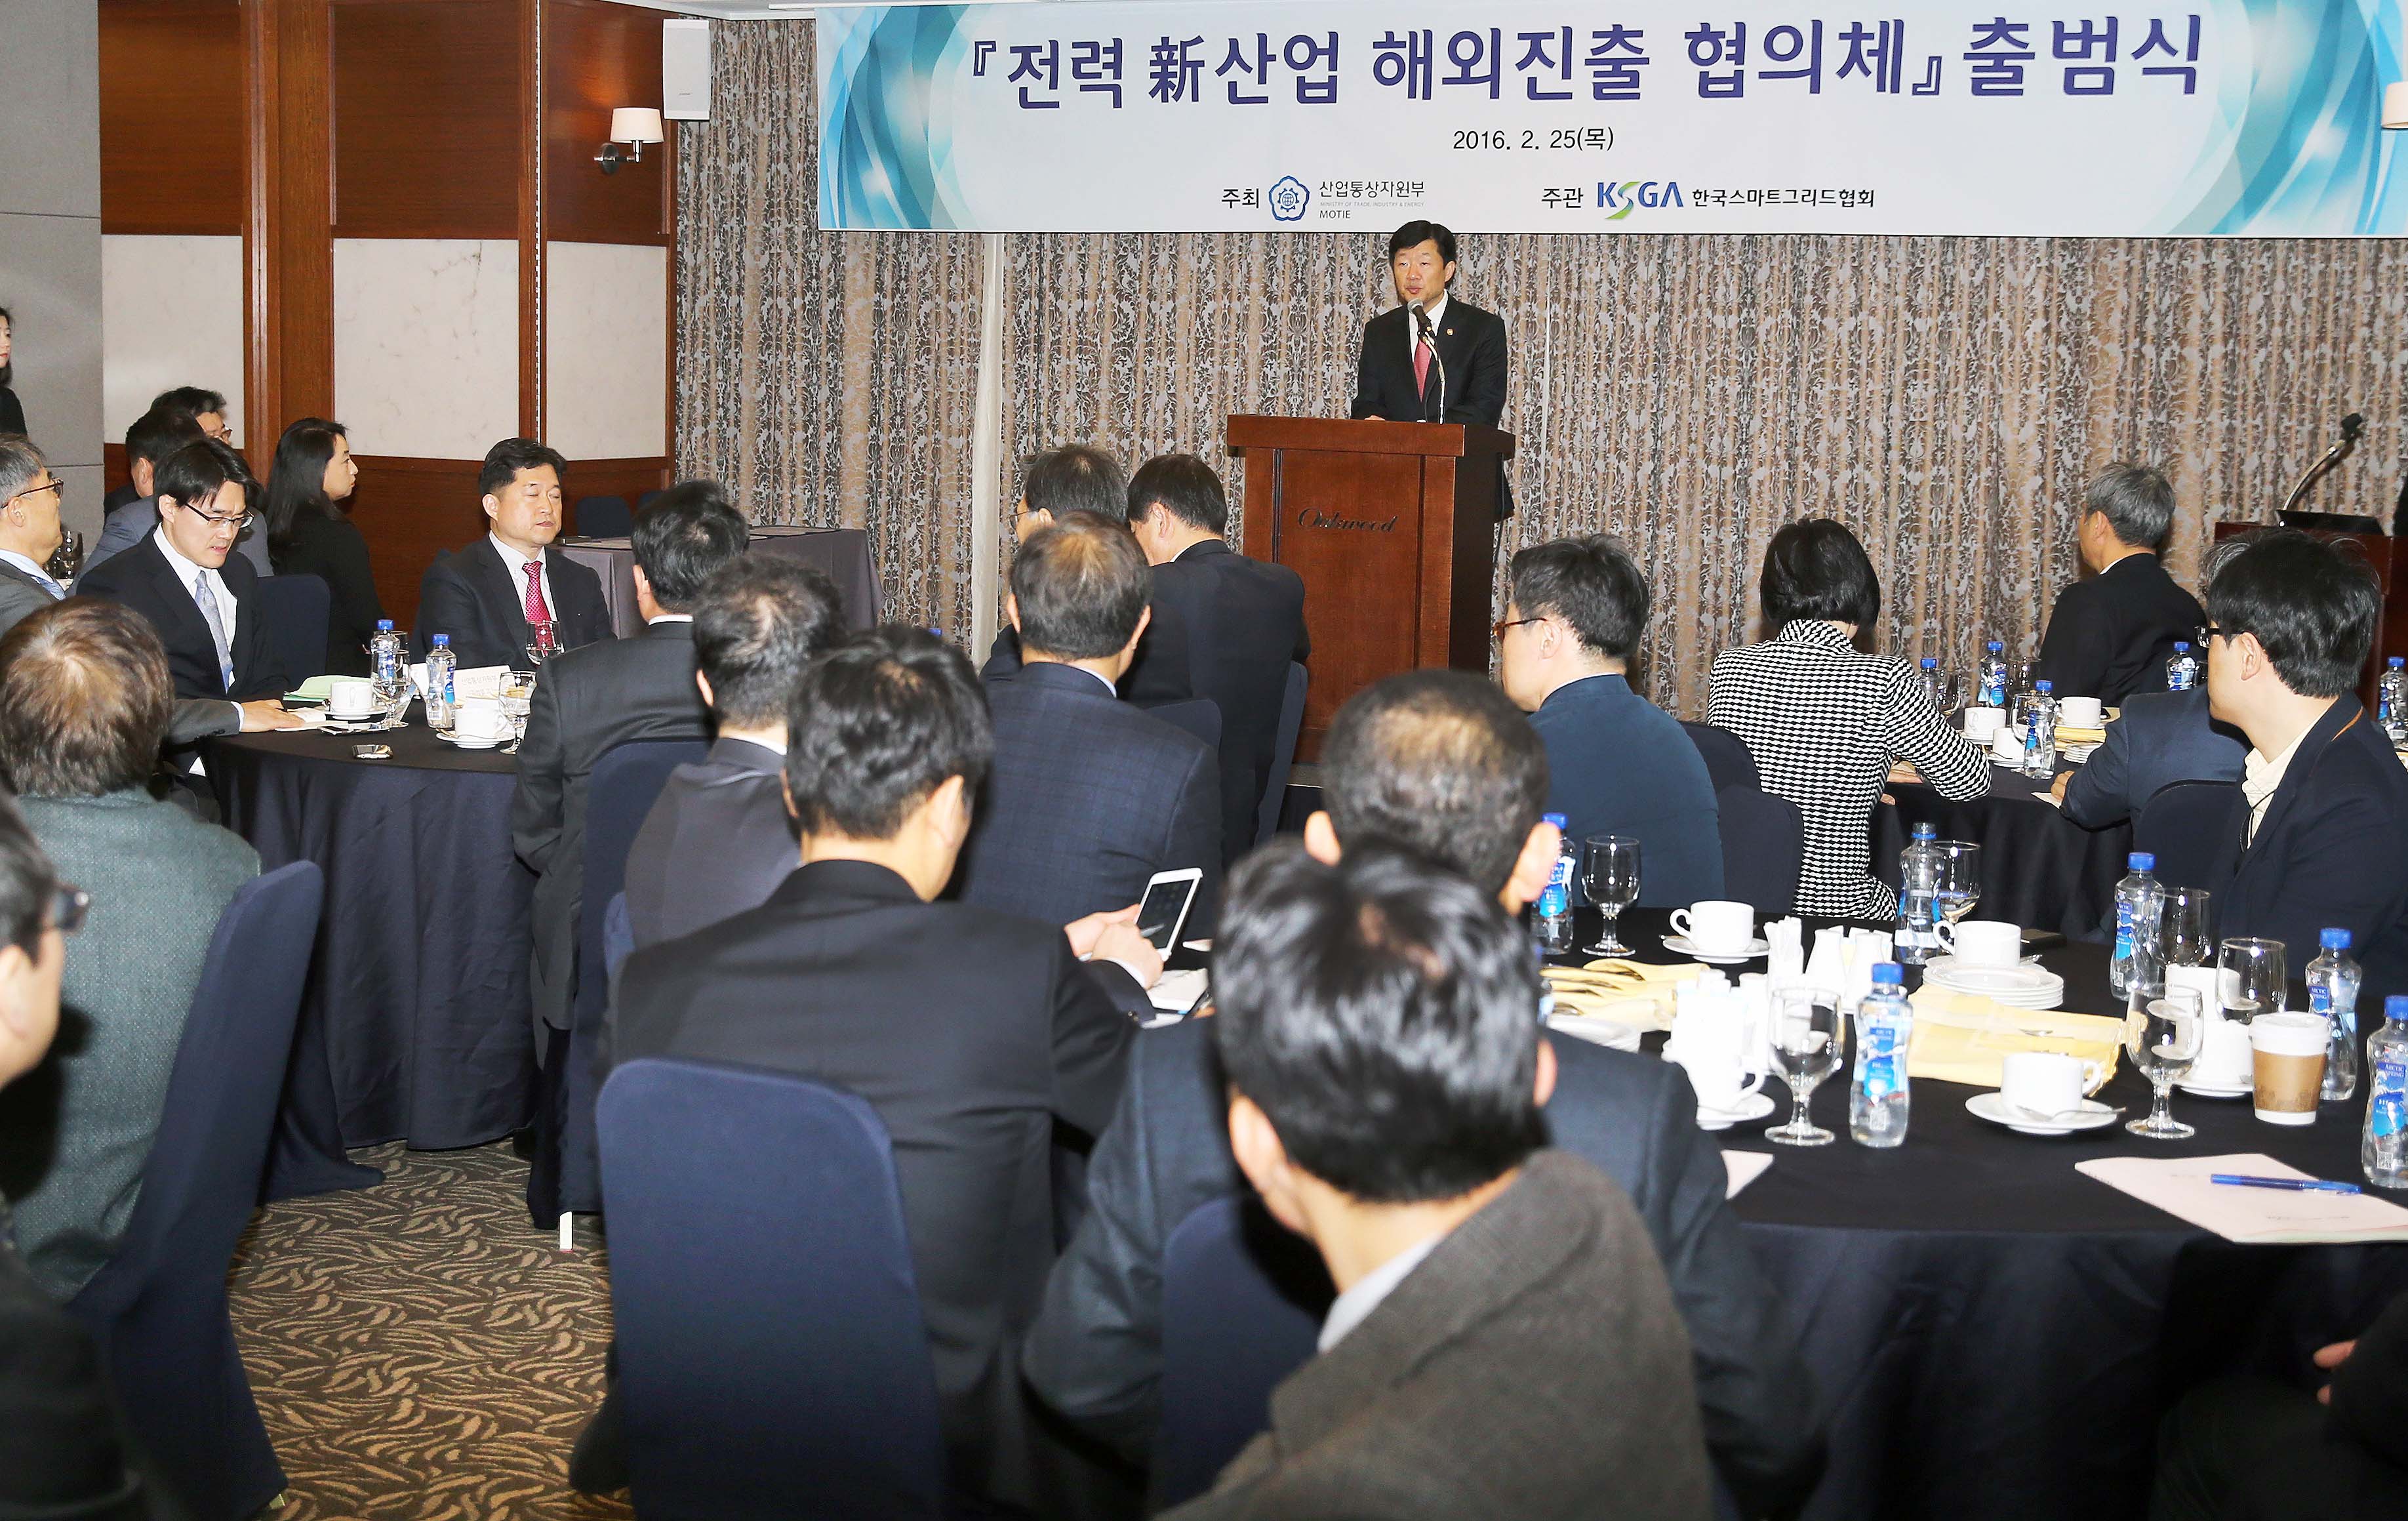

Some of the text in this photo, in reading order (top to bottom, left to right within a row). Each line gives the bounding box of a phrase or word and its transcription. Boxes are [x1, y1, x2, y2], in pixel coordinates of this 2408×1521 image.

[1372, 23, 1651, 101] 해외진출
[1453, 126, 1615, 152] 2016. 2. 25(목)
[1221, 188, 1260, 209] 주최
[1319, 180, 1425, 198] 산업통상자원부
[1541, 187, 1584, 209] 주관
[1692, 189, 1874, 208] 한국스마트그리드협회
[1319, 210, 1351, 219] MOTIE
